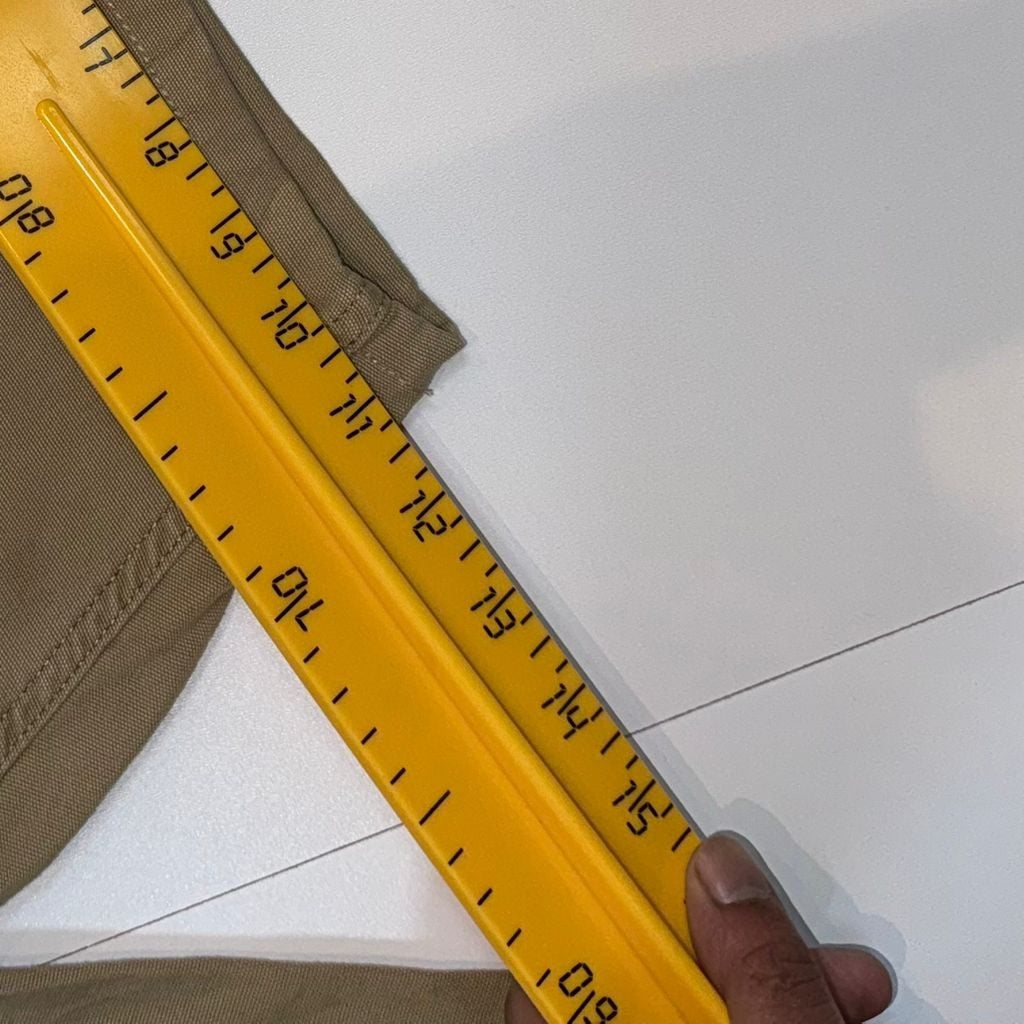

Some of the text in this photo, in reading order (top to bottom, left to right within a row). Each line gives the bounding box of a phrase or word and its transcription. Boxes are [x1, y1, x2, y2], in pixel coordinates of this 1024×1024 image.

[84, 46, 114, 73] 7
[144, 140, 180, 168] 8
[211, 232, 246, 260] 9
[261, 297, 310, 350] 10
[329, 393, 374, 440] 11
[399, 489, 448, 543] 12
[272, 566, 325, 632] 70
[470, 585, 517, 640] 13
[541, 683, 590, 740] 14
[612, 779, 660, 836] 15
